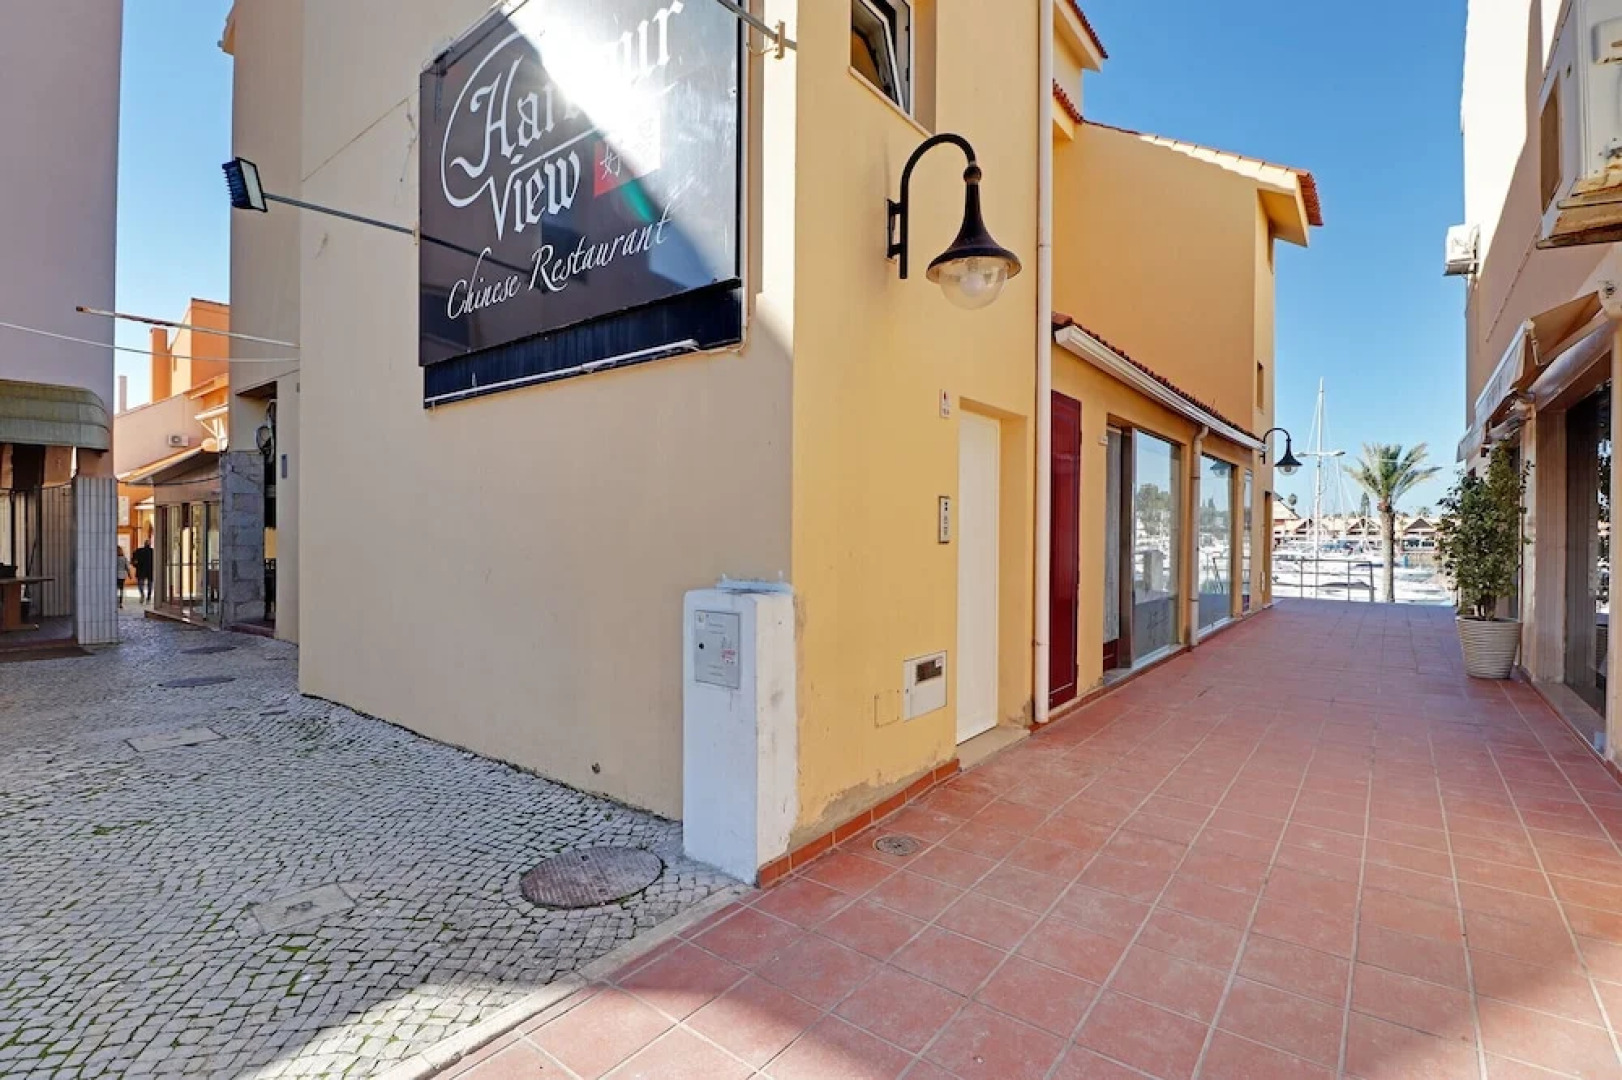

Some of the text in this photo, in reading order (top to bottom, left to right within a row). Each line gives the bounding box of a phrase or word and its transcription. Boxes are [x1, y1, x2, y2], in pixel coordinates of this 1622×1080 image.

[482, 151, 580, 241] View
[447, 199, 673, 320] Chinese Restaurant
